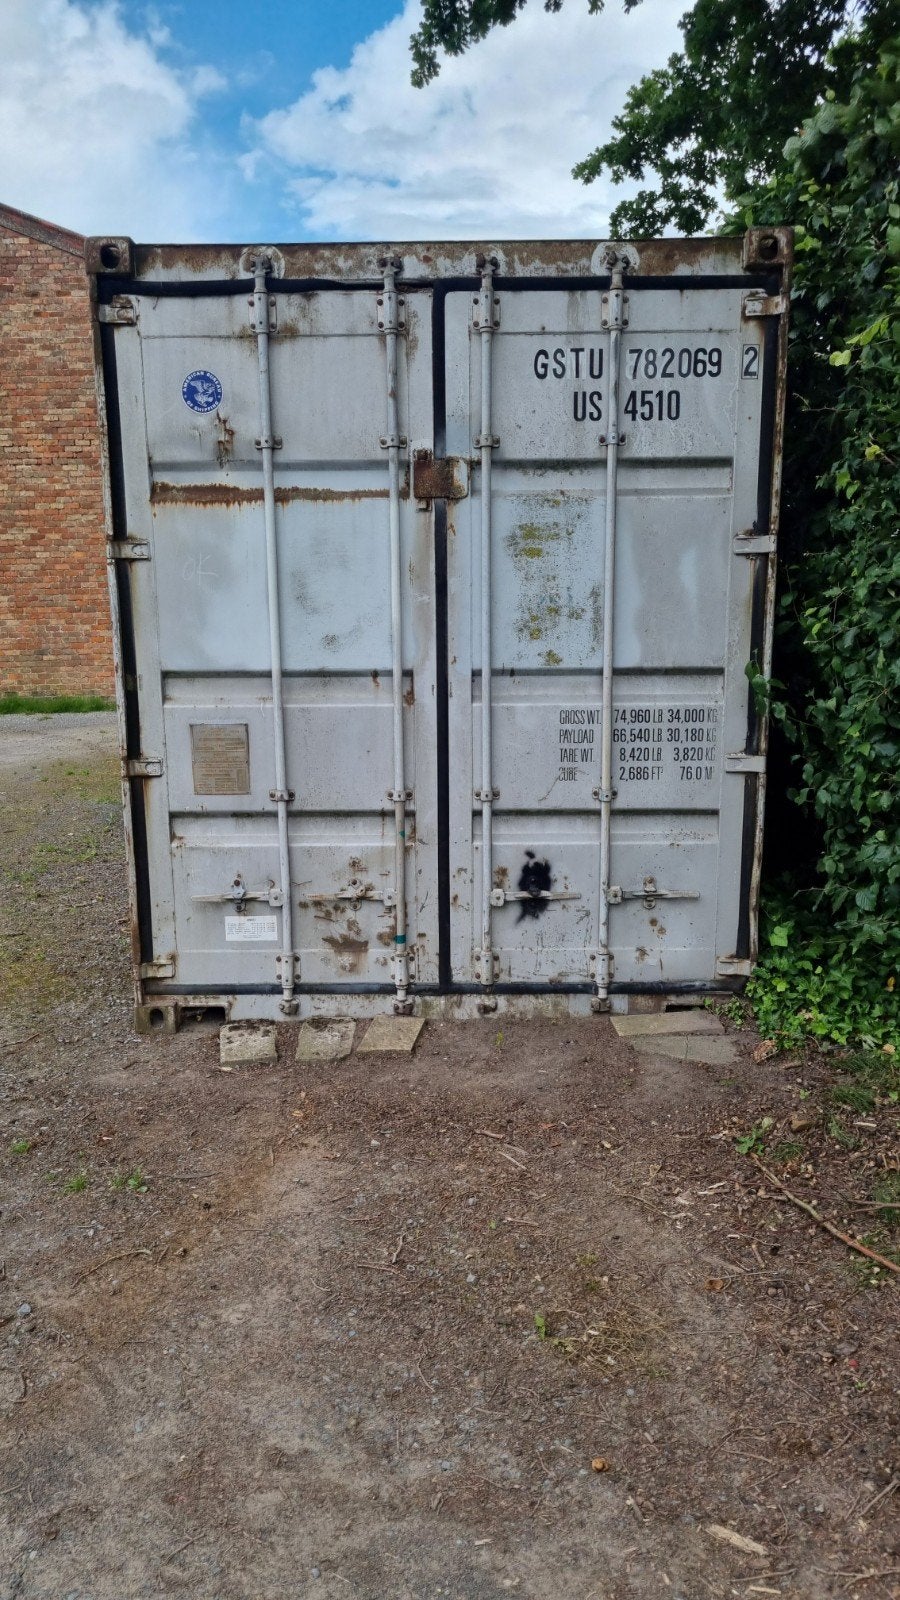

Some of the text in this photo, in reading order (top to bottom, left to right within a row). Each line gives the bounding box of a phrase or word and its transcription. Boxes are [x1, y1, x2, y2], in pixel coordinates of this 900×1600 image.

[534, 346, 758, 380] GSTU 782069 2
[183, 372, 221, 393] AMERICAN BUREAU
[194, 401, 219, 412] SHIPPING
[573, 390, 681, 422] US 4510
[559, 709, 585, 724] GROSS
[614, 708, 651, 725] 74,960
[667, 708, 705, 724] 34,000
[559, 728, 594, 744] PAYLOAD
[612, 728, 651, 744] 66,540
[666, 728, 704, 744] 30,180
[559, 748, 578, 763] TARE
[619, 747, 650, 763] 8,420
[673, 747, 704, 763] 3,820
[558, 766, 578, 781] CUBE
[619, 766, 649, 782] 2,686
